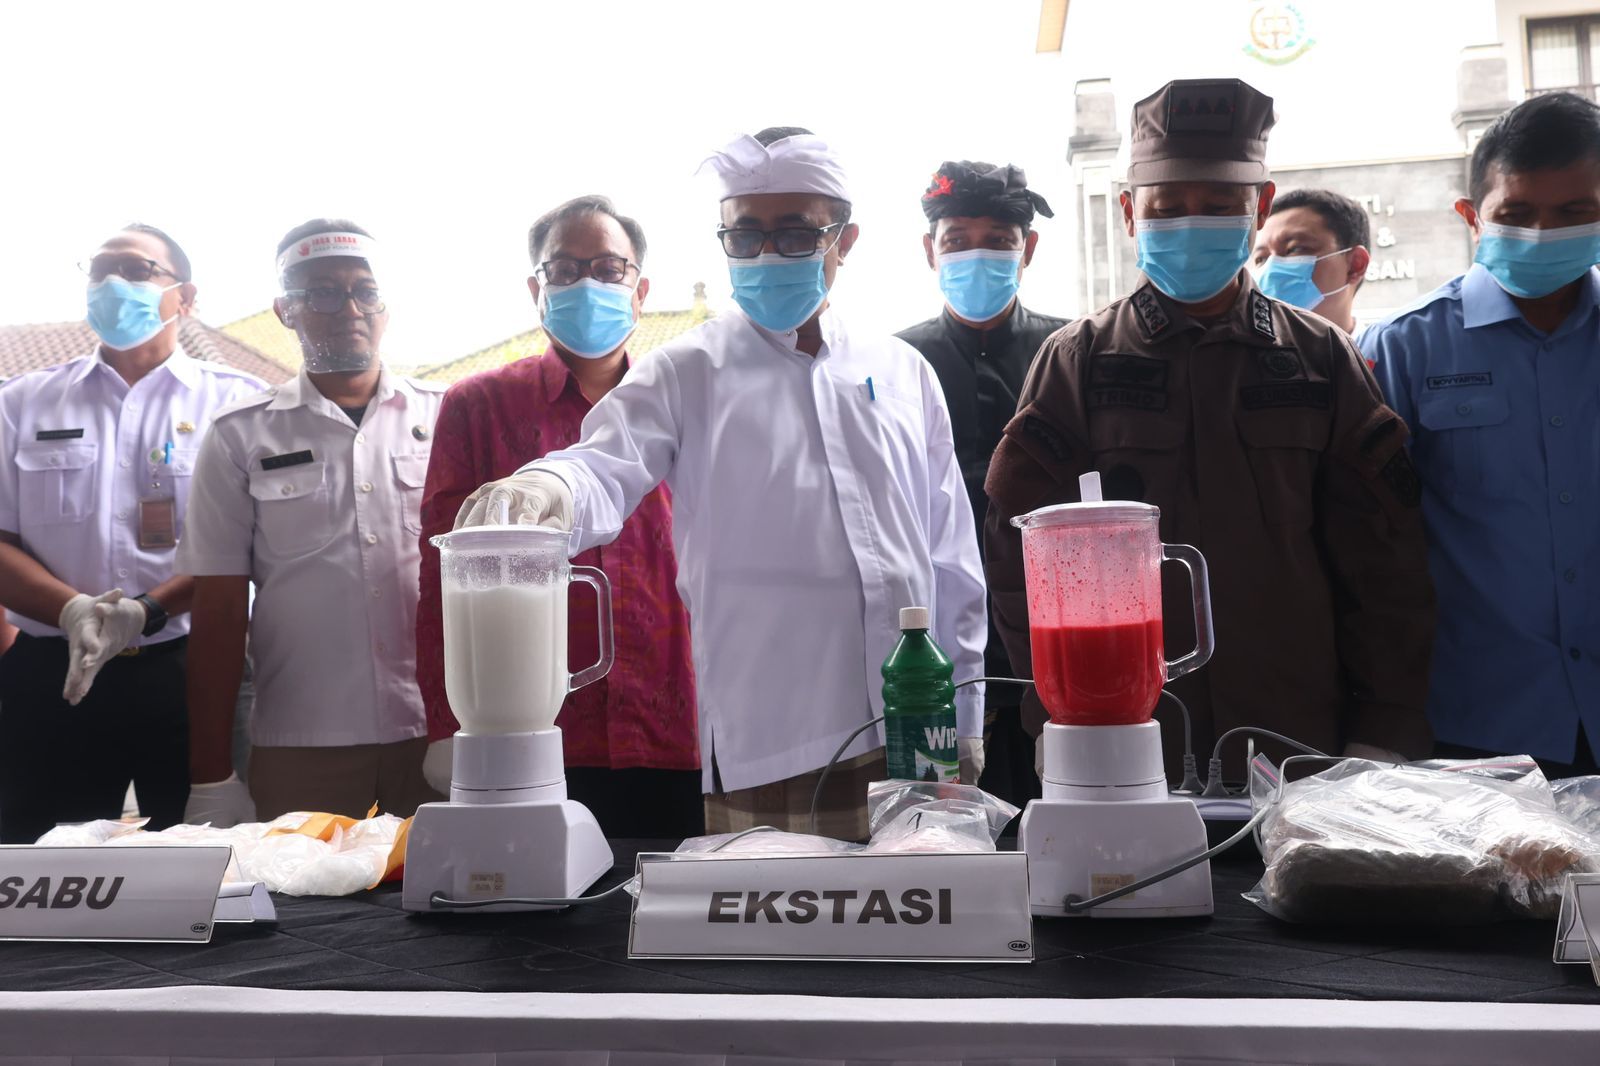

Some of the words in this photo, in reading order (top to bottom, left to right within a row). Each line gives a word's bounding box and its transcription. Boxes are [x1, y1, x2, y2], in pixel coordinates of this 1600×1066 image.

[1377, 226, 1396, 247] &
[0, 876, 125, 910] SABU
[707, 888, 952, 925] EKSTASI
